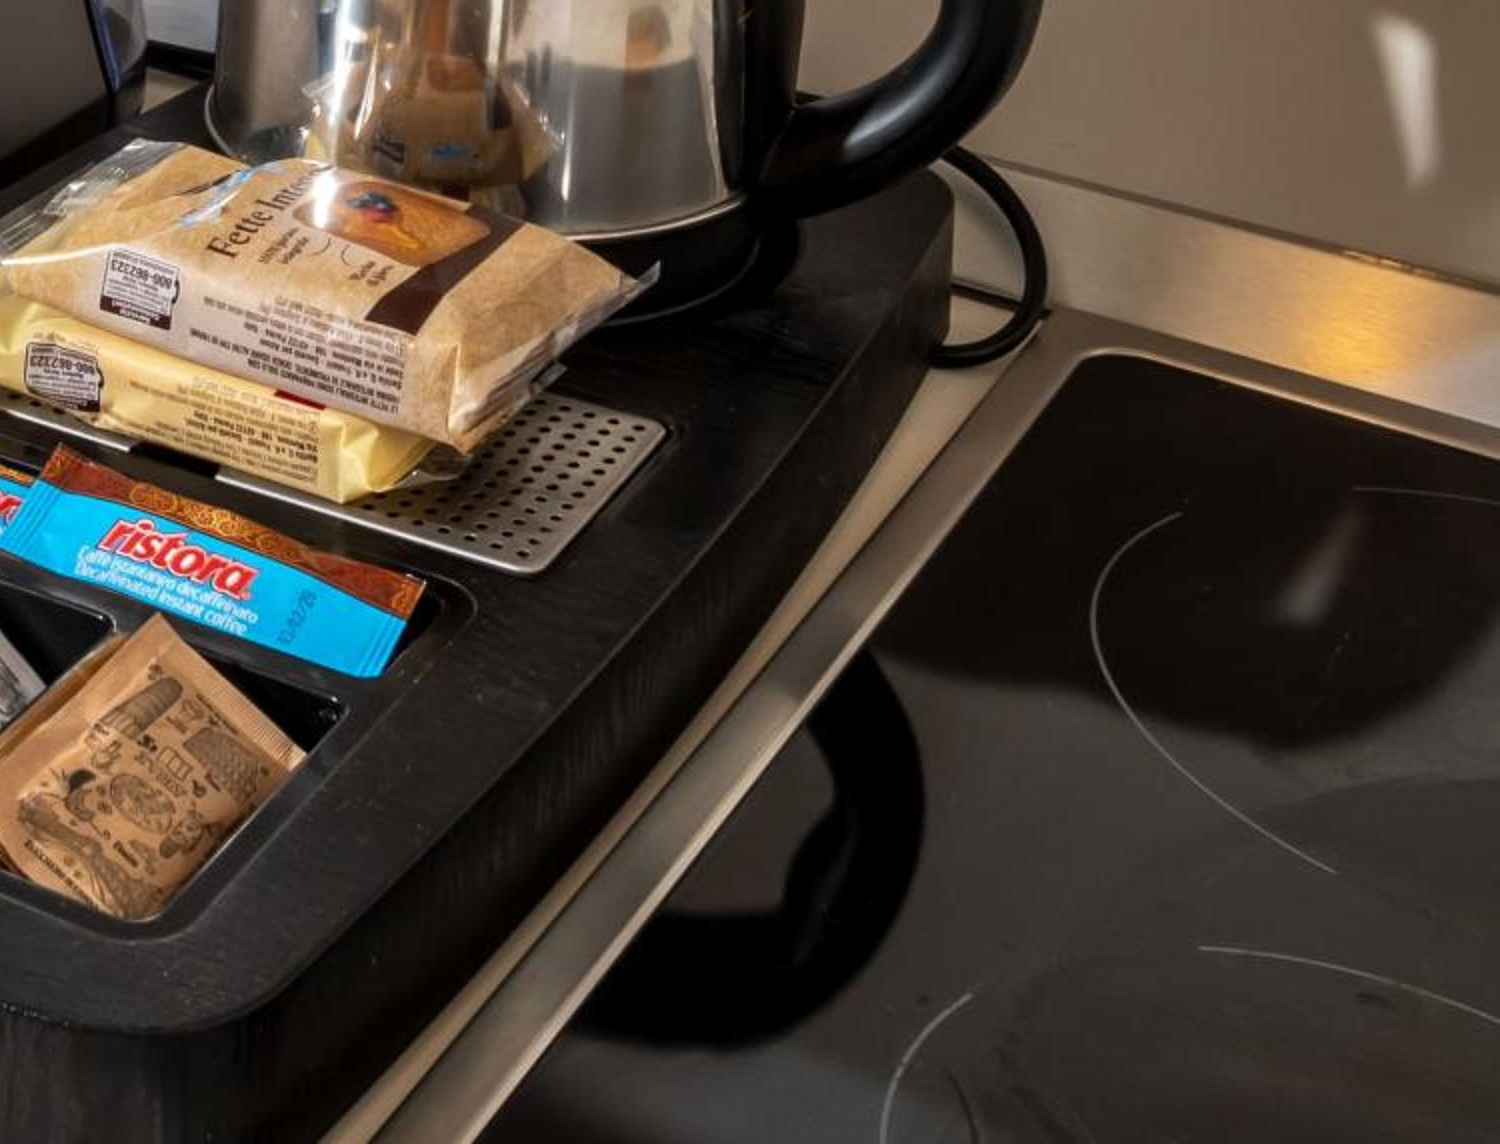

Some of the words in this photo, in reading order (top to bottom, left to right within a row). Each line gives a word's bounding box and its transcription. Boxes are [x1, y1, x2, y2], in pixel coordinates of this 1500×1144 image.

[206, 207, 274, 259] Fette
[96, 519, 261, 600] ristora
[203, 609, 249, 636] coffee
